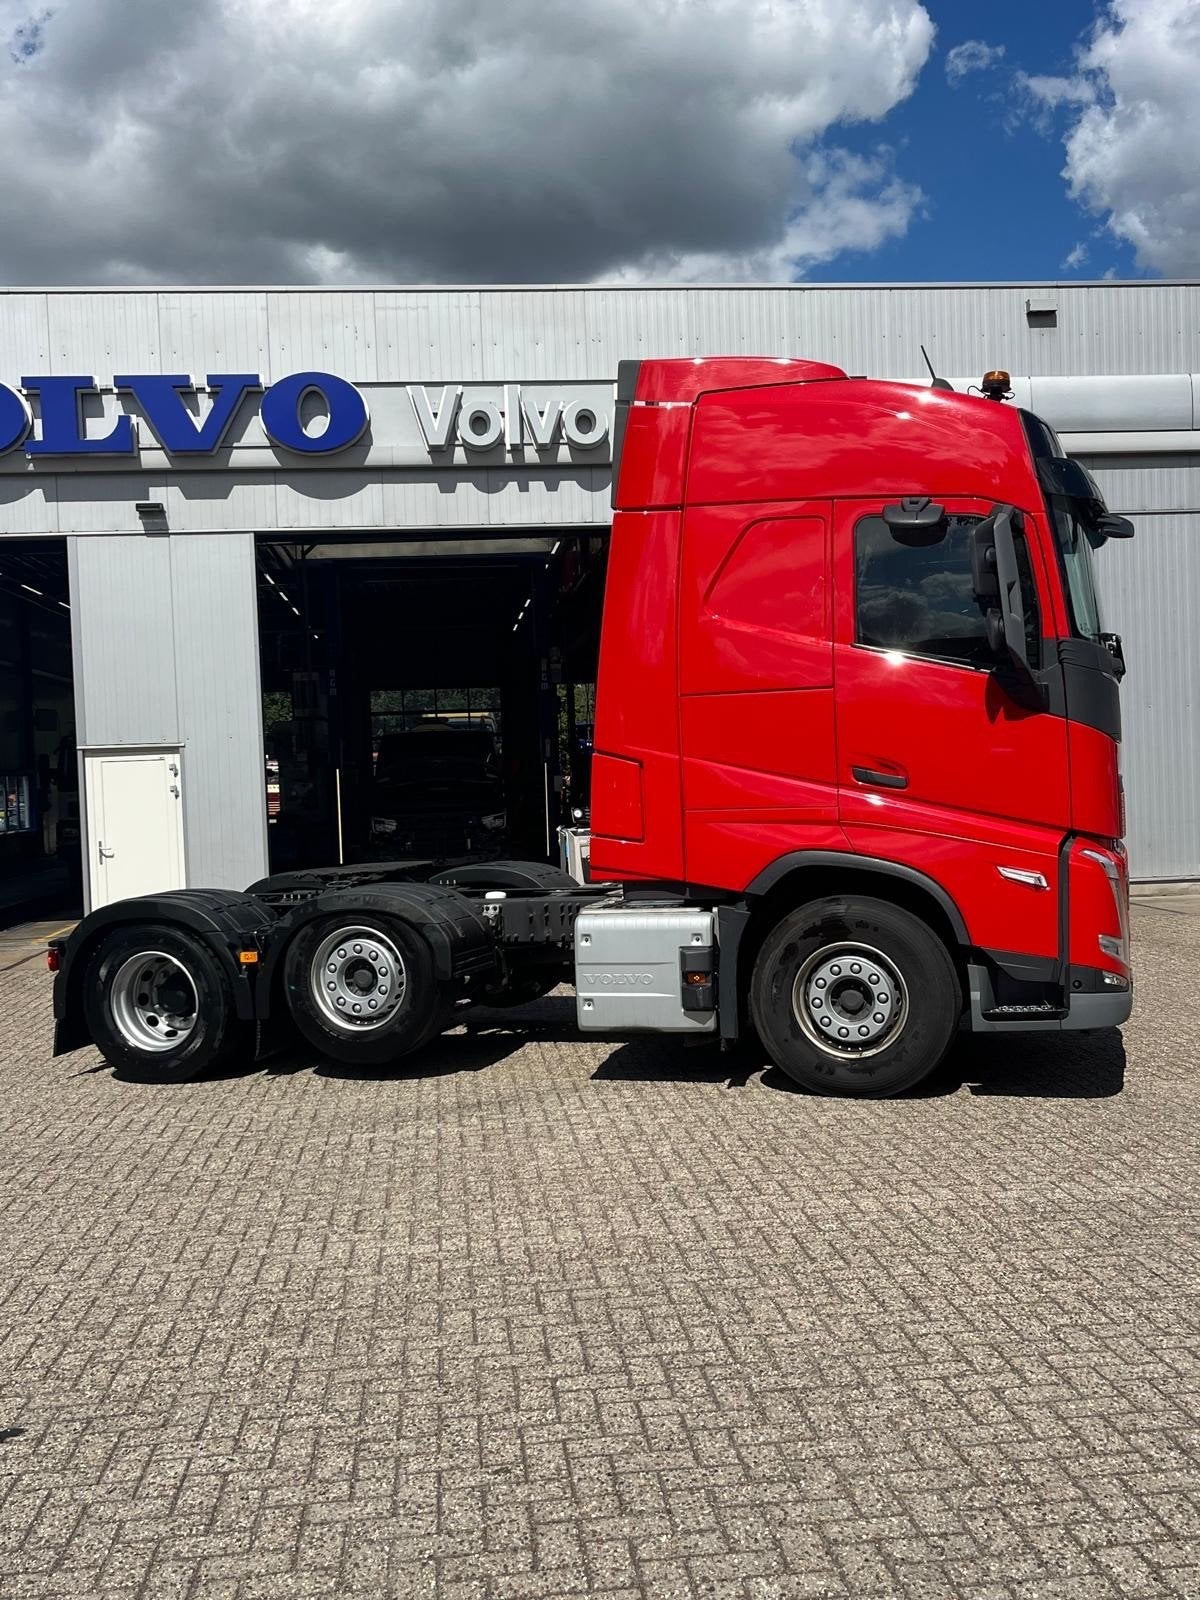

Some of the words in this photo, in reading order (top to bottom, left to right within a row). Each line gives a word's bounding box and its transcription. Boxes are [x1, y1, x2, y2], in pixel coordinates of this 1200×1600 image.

[0, 371, 369, 458] LVO
[406, 384, 608, 450] Volvo
[582, 972, 655, 985] VOLVO
